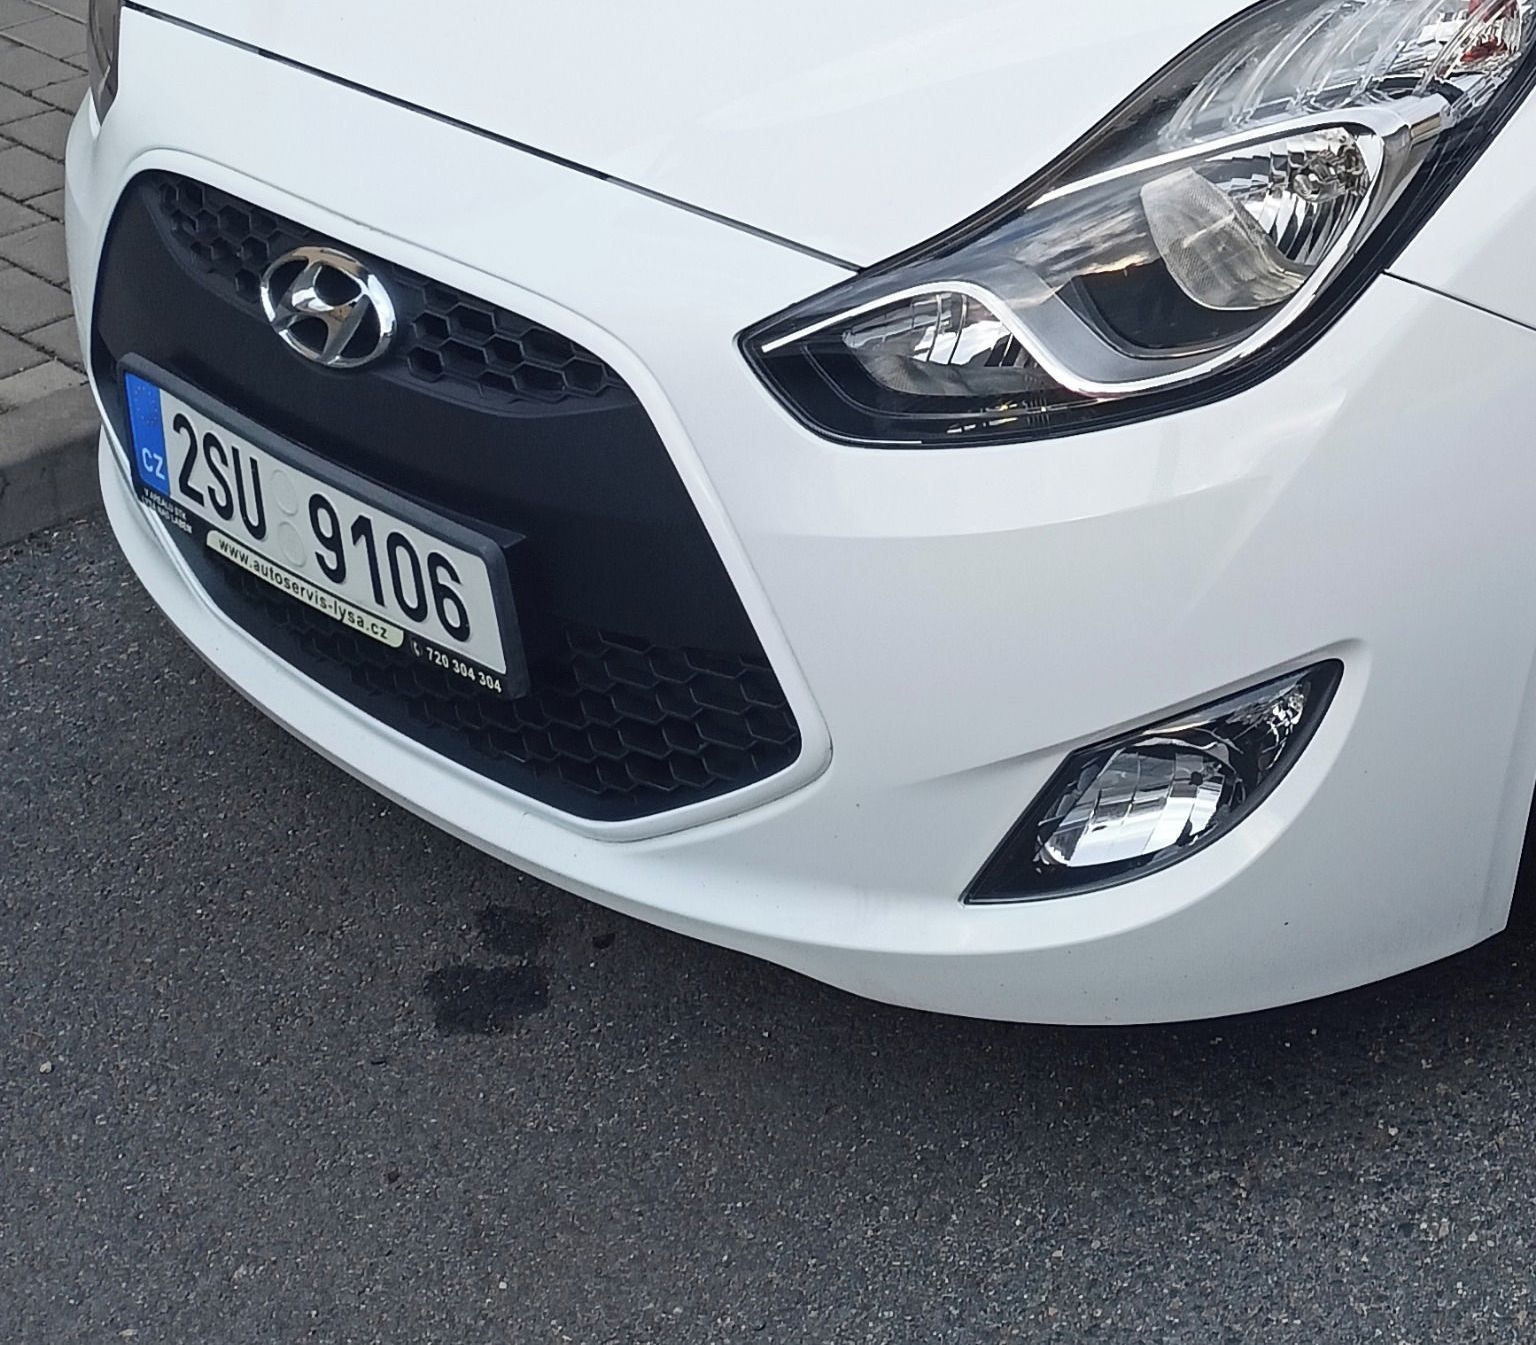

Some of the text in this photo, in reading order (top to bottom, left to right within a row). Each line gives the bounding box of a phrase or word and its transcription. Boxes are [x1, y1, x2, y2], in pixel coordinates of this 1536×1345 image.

[142, 447, 166, 481] CZ
[172, 413, 471, 642] 2SU 9106
[218, 538, 389, 640] www.autoservis-lysa.cz
[426, 646, 502, 693] 720 304 304
